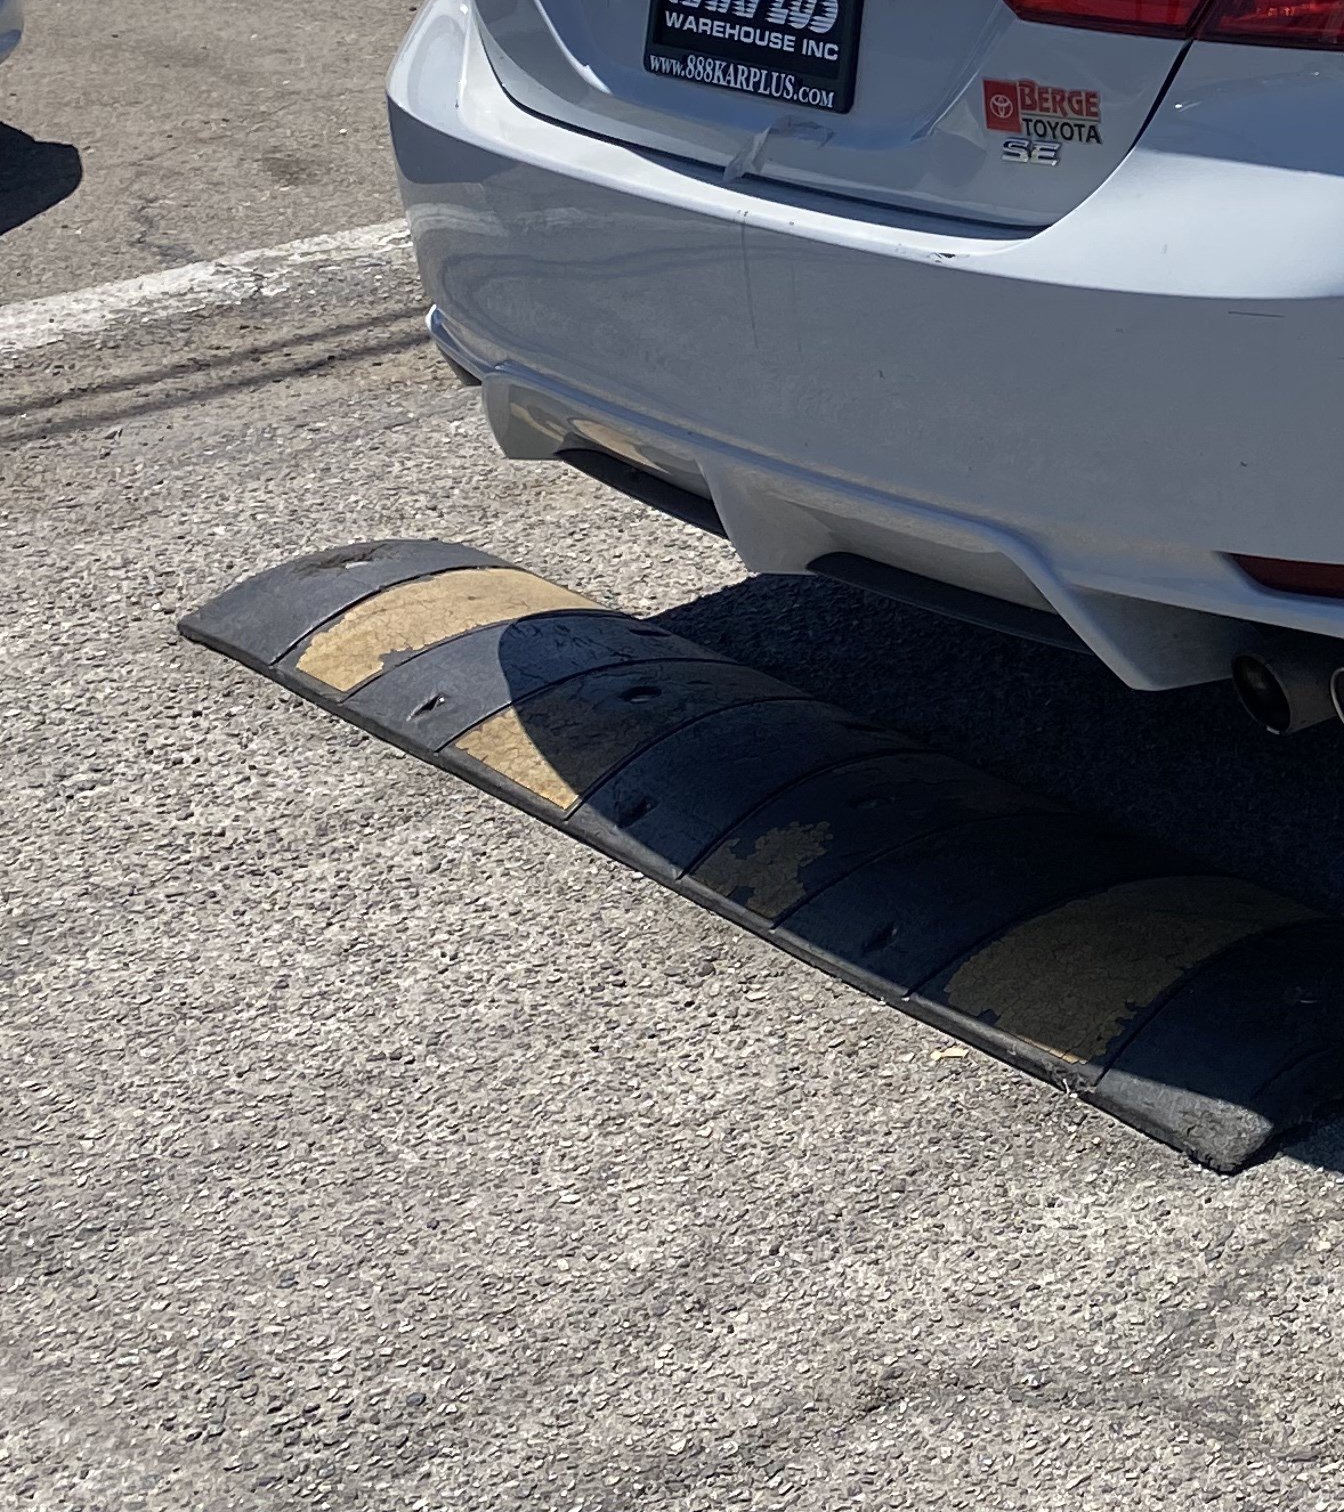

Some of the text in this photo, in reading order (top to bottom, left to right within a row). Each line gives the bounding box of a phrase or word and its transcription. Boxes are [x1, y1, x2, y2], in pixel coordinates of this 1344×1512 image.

[664, 10, 839, 61] WAREHOUSE INC
[1021, 117, 1103, 145] TOYOTA
[1001, 136, 1062, 167] SE
